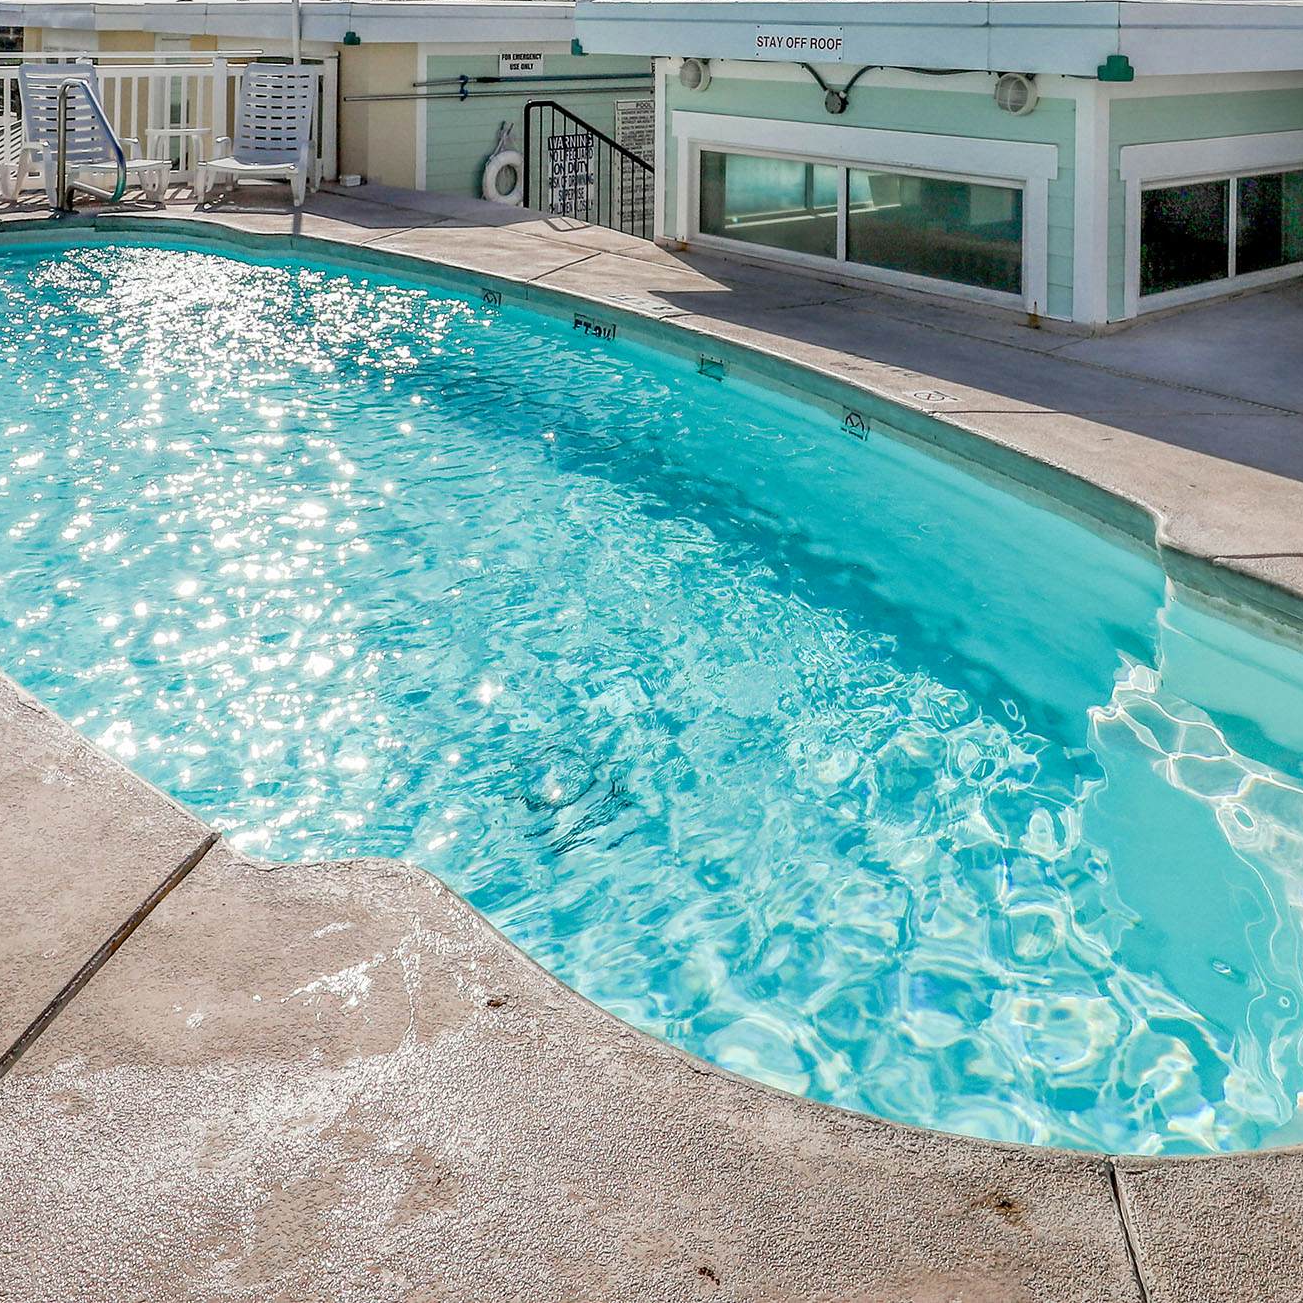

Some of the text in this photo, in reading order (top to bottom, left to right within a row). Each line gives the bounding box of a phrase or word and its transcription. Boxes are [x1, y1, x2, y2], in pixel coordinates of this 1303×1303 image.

[756, 36, 843, 50] STAY OFF ROOF
